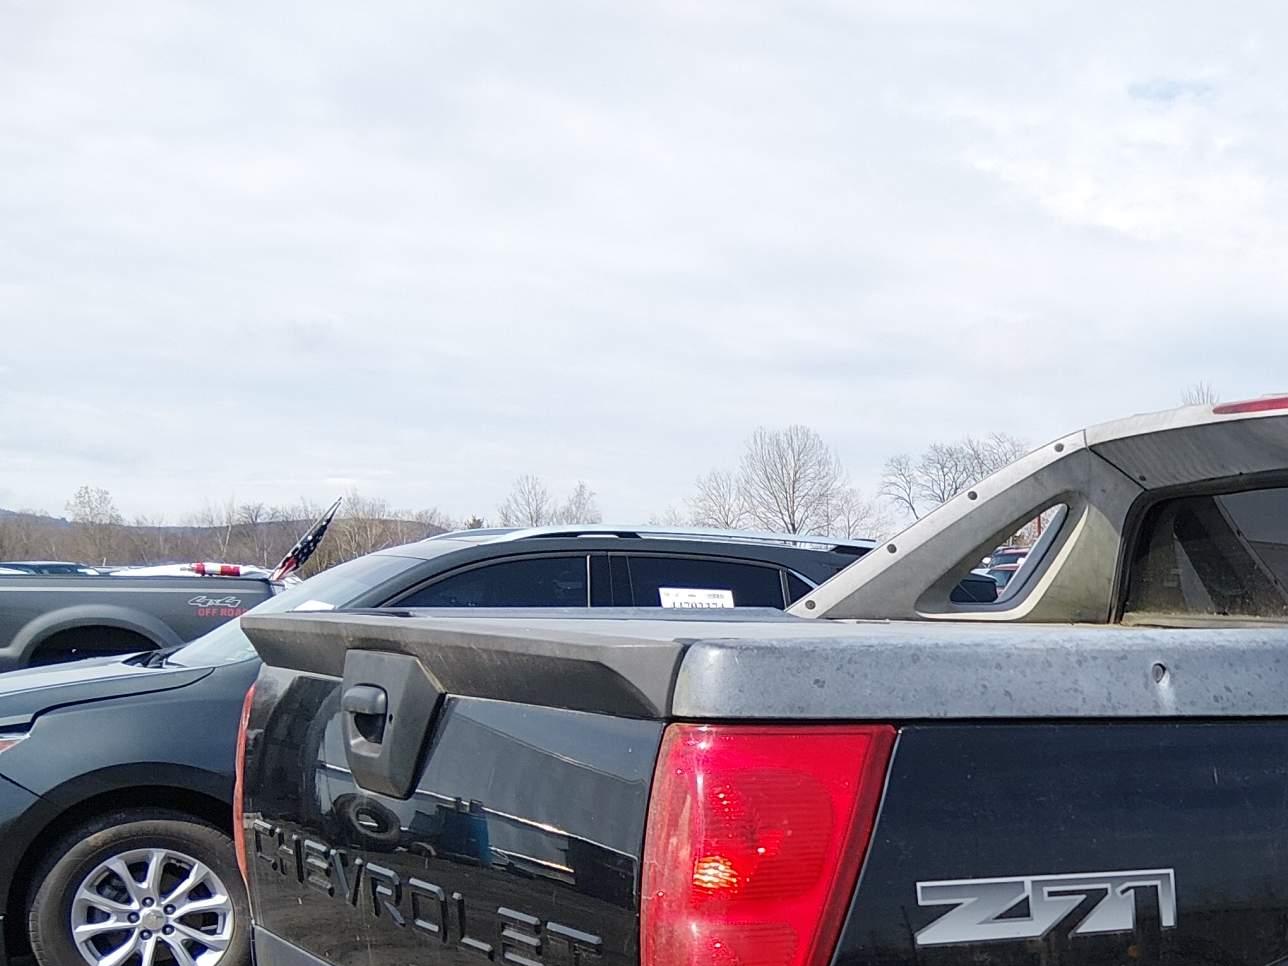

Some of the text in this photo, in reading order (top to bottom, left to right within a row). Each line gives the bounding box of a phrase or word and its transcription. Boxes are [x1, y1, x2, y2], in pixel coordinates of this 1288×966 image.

[187, 595, 242, 608] 4x4
[197, 608, 218, 617] OFF
[914, 867, 1177, 948] Z71
